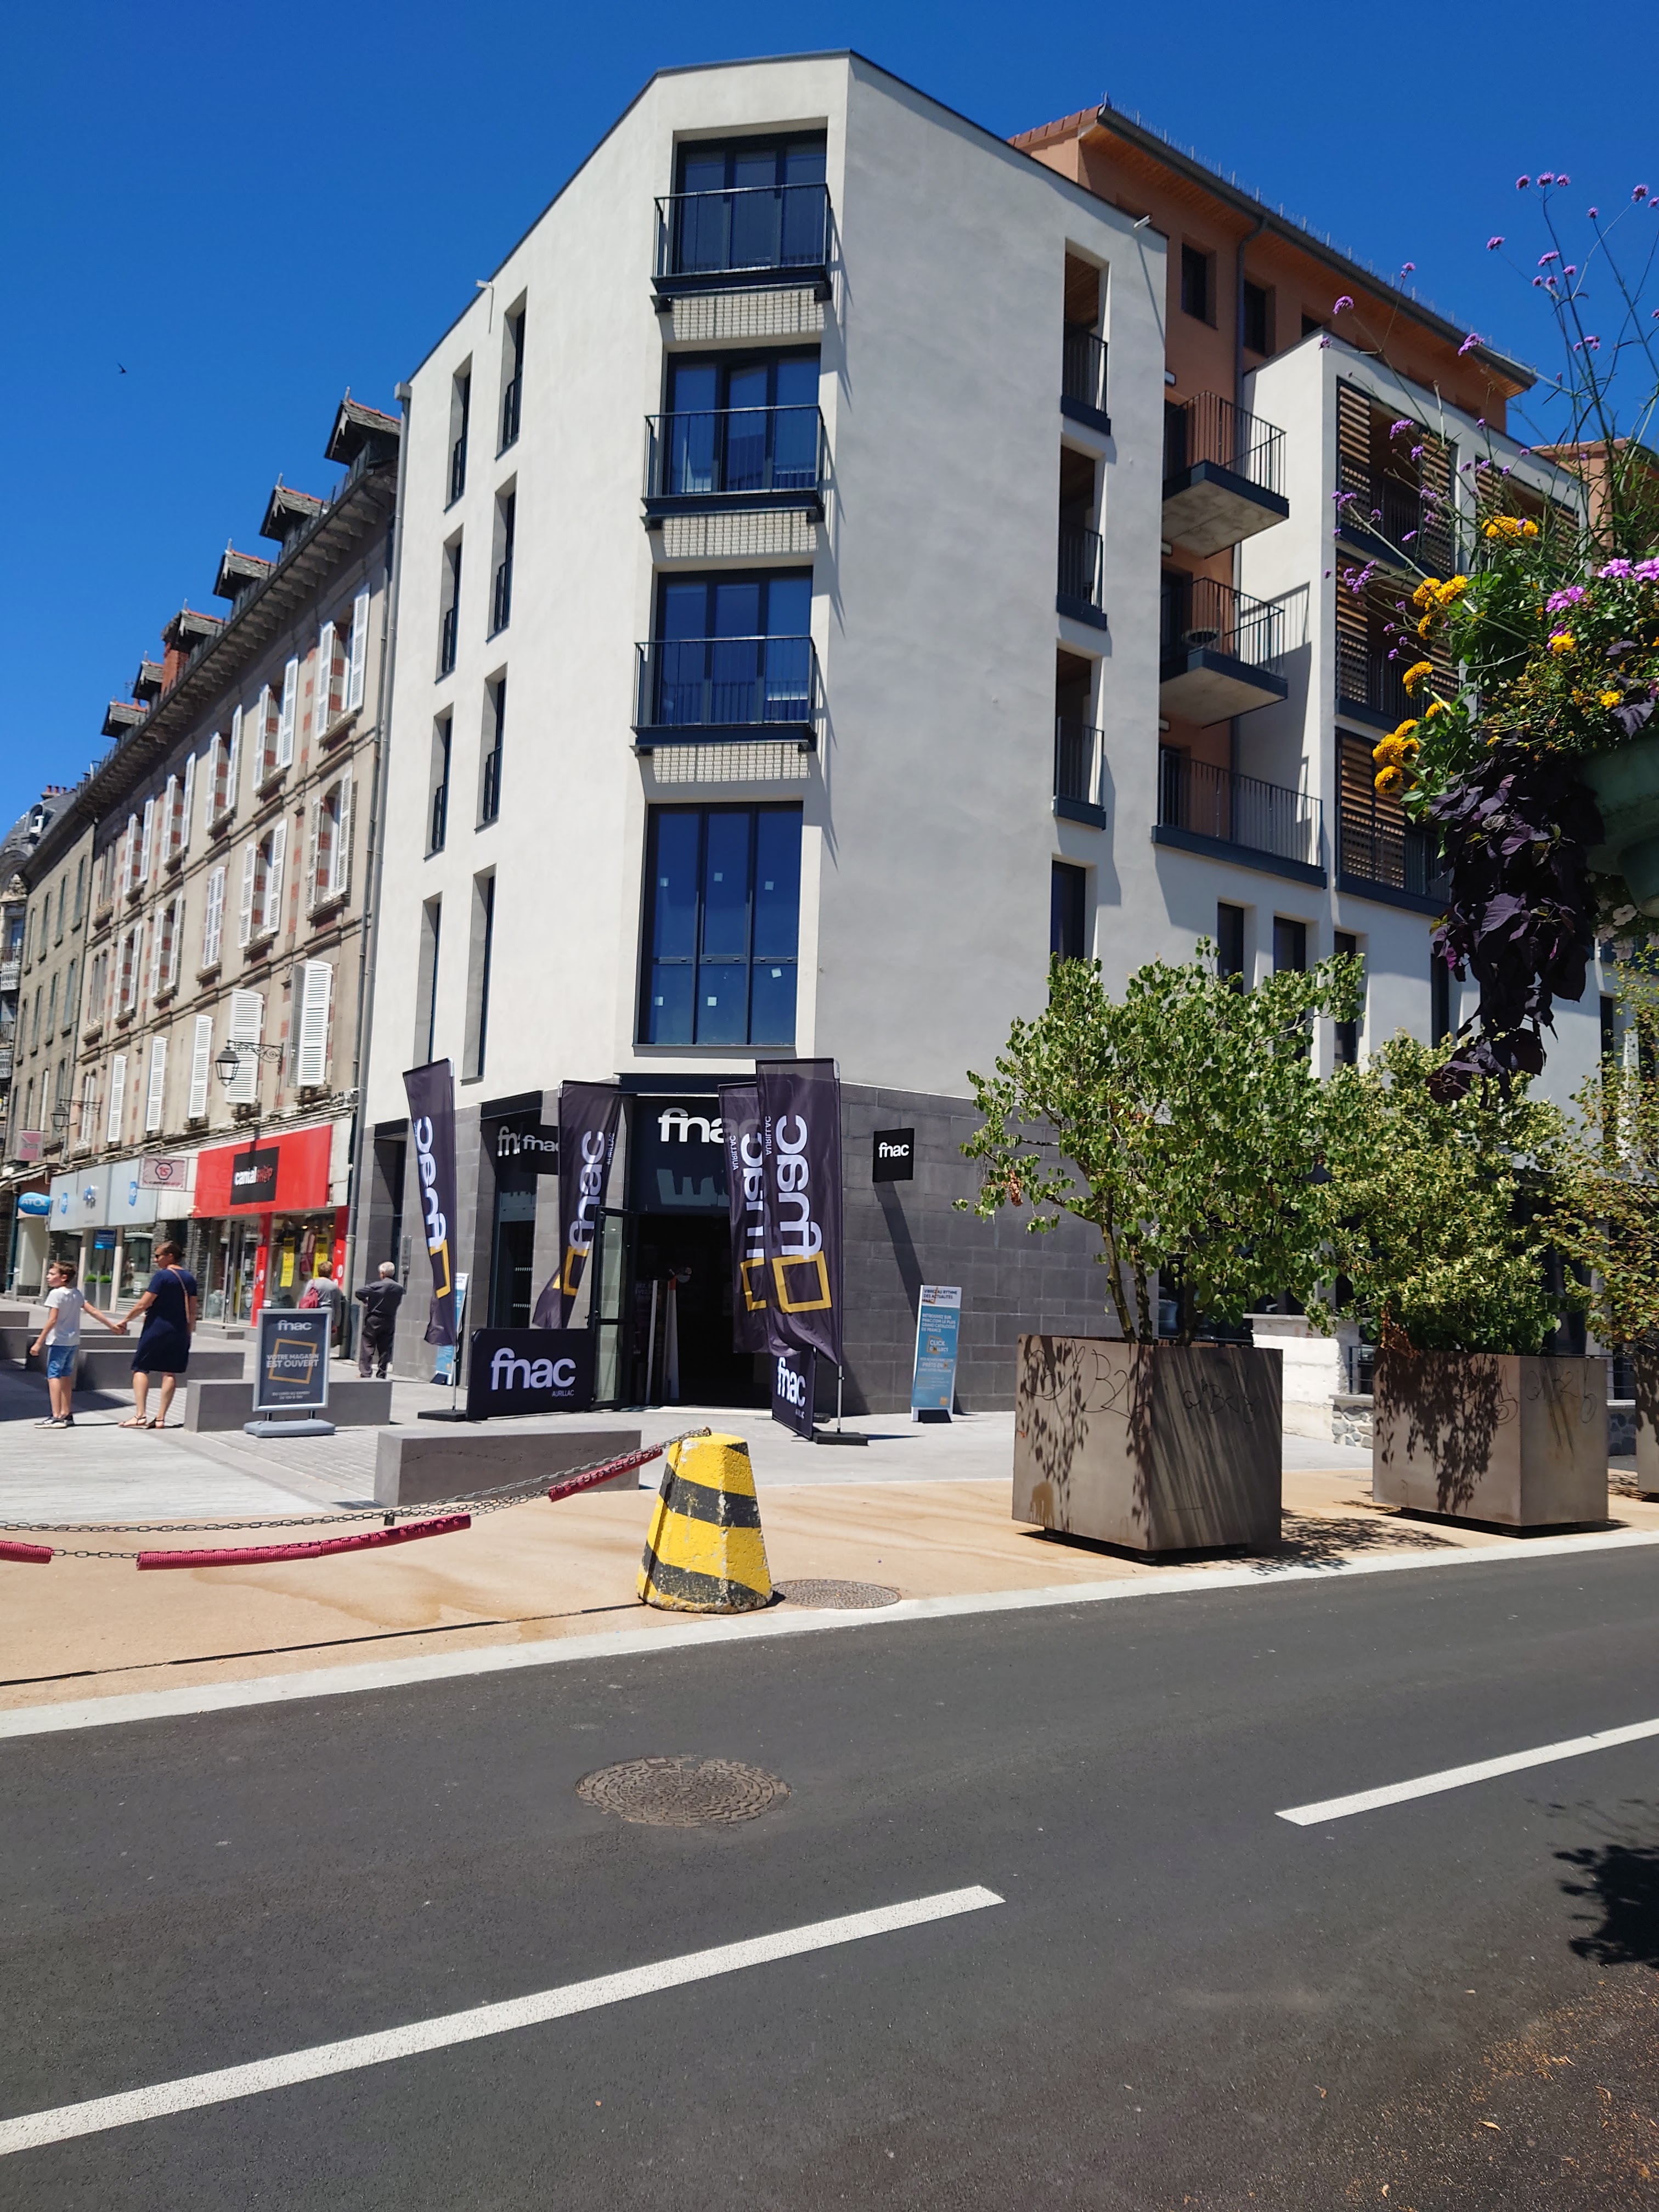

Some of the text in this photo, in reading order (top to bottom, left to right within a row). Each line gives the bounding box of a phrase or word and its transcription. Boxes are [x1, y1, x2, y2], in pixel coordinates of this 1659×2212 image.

[523, 1135, 558, 1152] fna
[878, 1142, 910, 1158] fnac
[569, 1131, 605, 1251] fnac
[21, 1198, 47, 1207] ATOL
[278, 1319, 312, 1331] fnac
[284, 1359, 319, 1368] OUVERT
[490, 1347, 576, 1390] fnac
[777, 1357, 806, 1407] fnac
